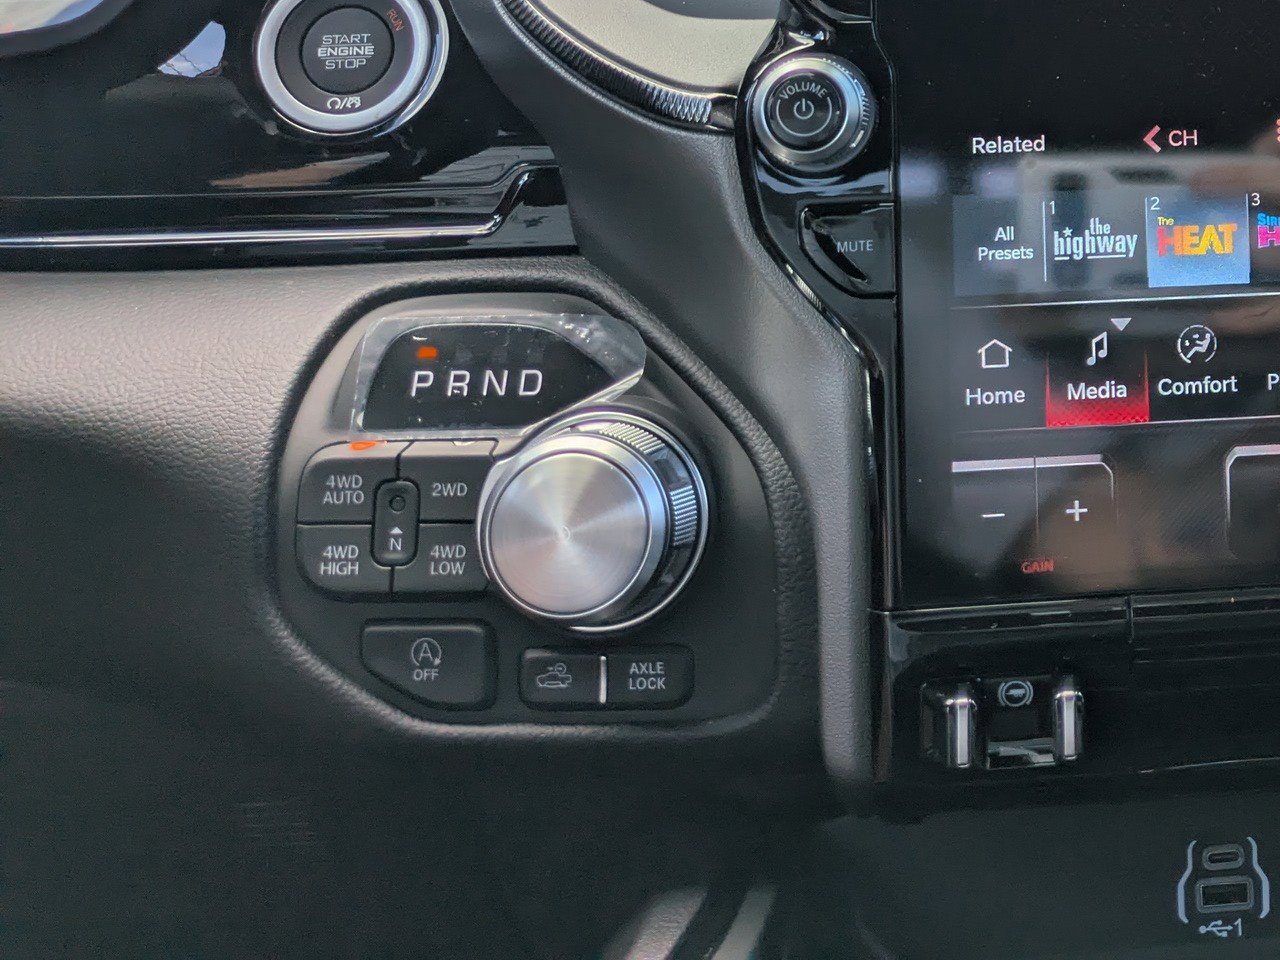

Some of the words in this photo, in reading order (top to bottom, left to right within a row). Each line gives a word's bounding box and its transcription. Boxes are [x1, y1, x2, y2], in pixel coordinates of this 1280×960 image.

[386, 8, 405, 32] RUN
[322, 33, 371, 45] START
[317, 45, 375, 57] ENGINE
[325, 58, 367, 70] STOP
[779, 81, 828, 101] VOLUME
[972, 134, 1046, 155] Related
[1168, 129, 1199, 147] CH
[1150, 196, 1161, 211] 2
[1251, 192, 1261, 207] 3
[1049, 200, 1056, 215] 1
[1089, 217, 1111, 236] the
[1157, 216, 1175, 227] The
[994, 226, 1015, 242] All
[1157, 223, 1238, 257] HEAT
[836, 239, 874, 253] MUTE
[1053, 231, 1138, 261] highway
[977, 246, 1034, 262] Presets
[1066, 380, 1128, 401] Media
[1157, 374, 1239, 397] Comfort
[965, 387, 1026, 406] Home
[326, 474, 363, 489] 4WD
[322, 490, 365, 505] AUTO
[431, 483, 468, 498] 2WD
[323, 545, 360, 560] 4WD
[390, 538, 402, 552] N
[430, 545, 467, 559] 4WD
[320, 561, 360, 576] HIGH
[429, 561, 466, 576] LOW
[412, 668, 440, 682] OFF
[629, 662, 665, 675] AXLE
[628, 676, 667, 690] LOCK
[1234, 917, 1244, 937] 1
